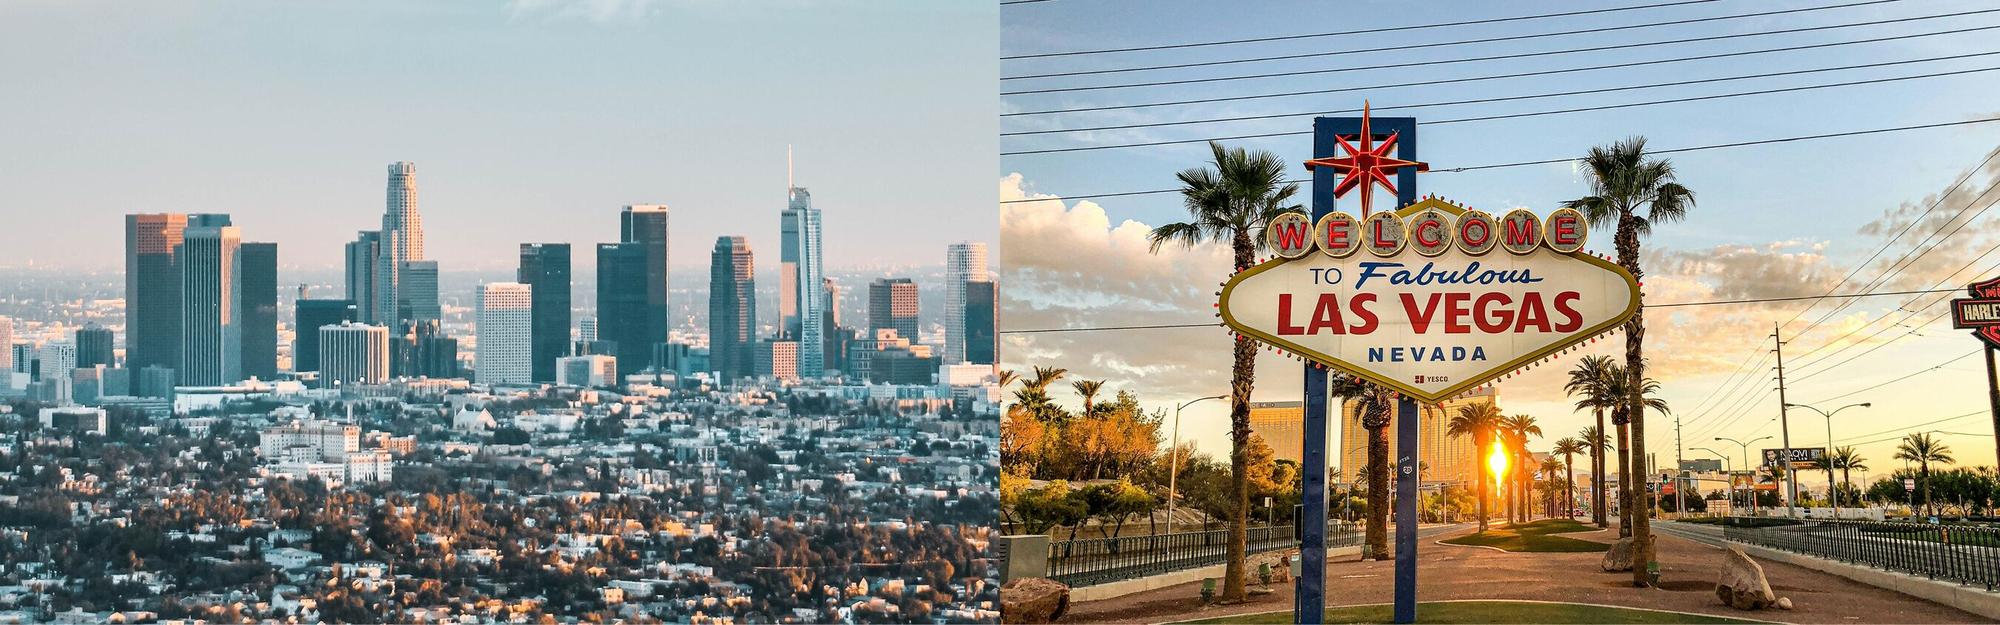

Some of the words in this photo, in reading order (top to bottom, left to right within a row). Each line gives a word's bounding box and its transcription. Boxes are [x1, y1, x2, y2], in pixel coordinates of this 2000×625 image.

[1276, 216, 1577, 250] WELCOME
[1309, 268, 1342, 285] TO
[1355, 261, 1543, 290] Fabulous
[1277, 293, 1379, 335] LAS
[1399, 291, 1583, 334] VEGAS
[1963, 303, 2000, 320] HARLE
[1368, 346, 1487, 363] NEVADA
[1427, 375, 1449, 383] YESCO
